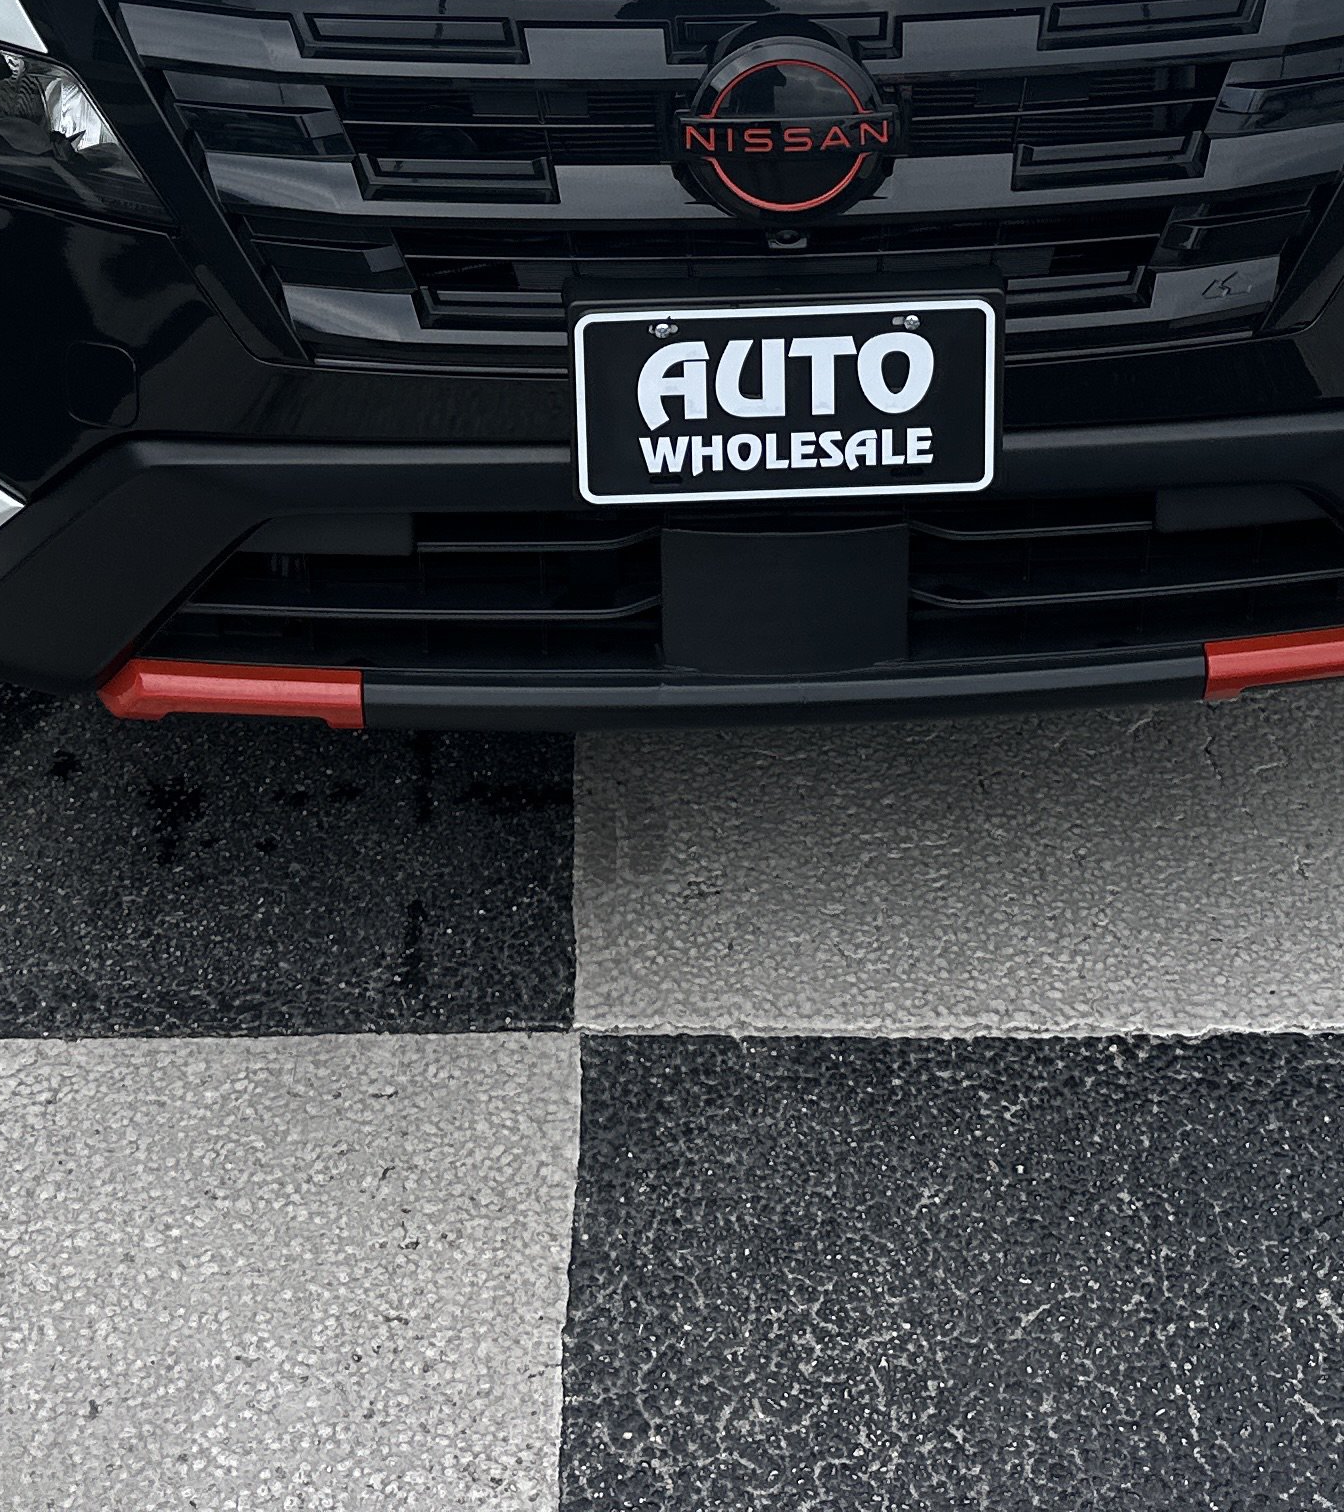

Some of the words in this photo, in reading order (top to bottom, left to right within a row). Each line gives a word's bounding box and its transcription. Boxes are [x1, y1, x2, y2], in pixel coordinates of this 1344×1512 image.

[685, 118, 890, 154] NISSAN
[637, 331, 935, 432] AUTO
[638, 426, 934, 478] WHOLESALE
